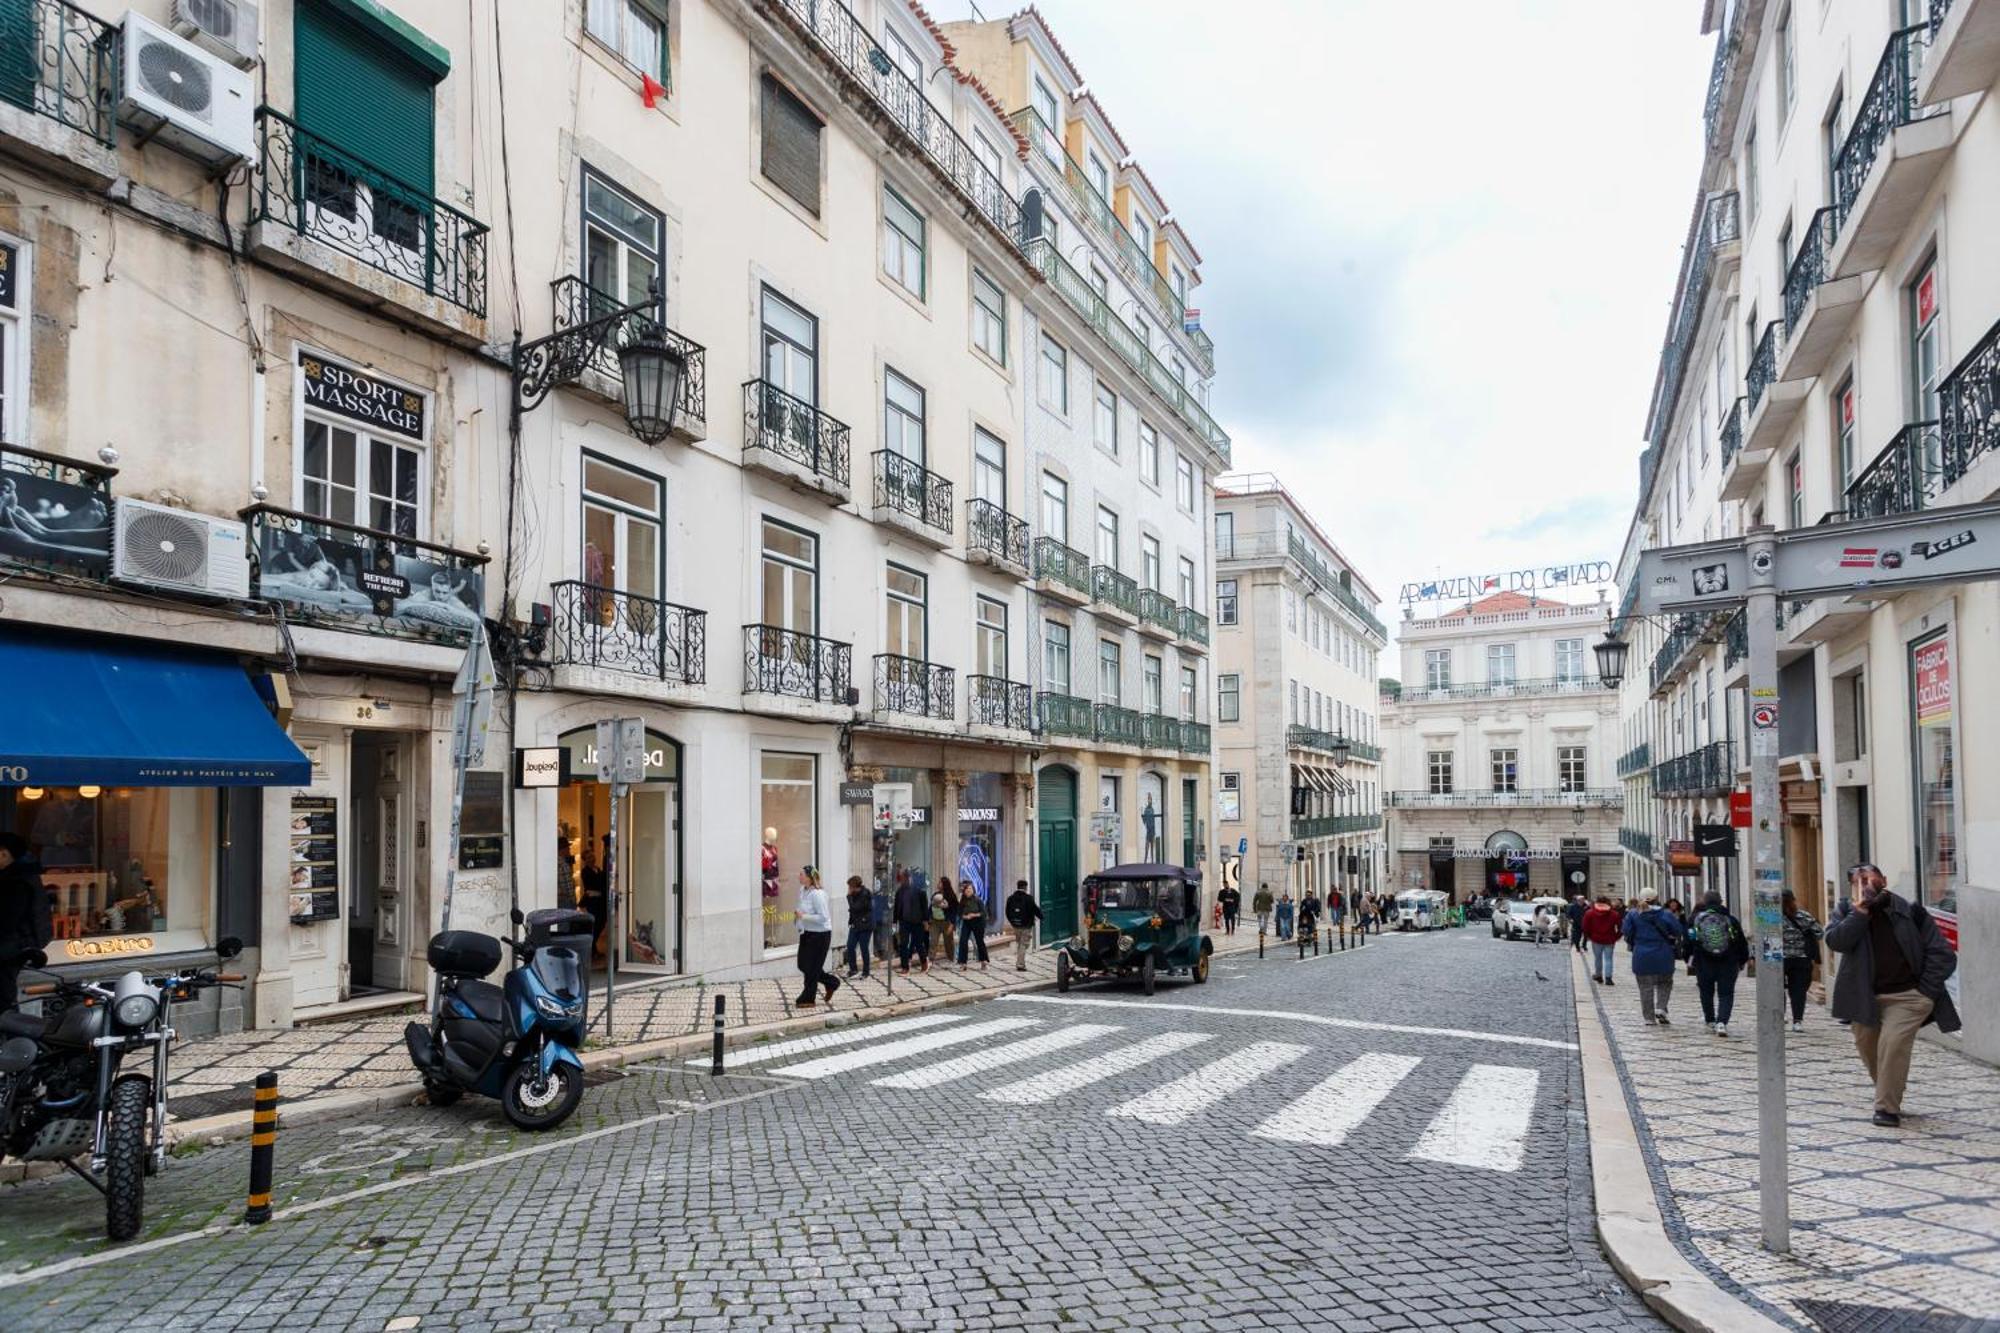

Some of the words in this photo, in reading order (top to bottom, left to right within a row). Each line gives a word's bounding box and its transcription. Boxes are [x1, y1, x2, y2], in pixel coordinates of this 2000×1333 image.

[304, 378, 418, 432] MASSAGE
[323, 366, 402, 406] SPORT
[1926, 531, 1971, 556] ACES
